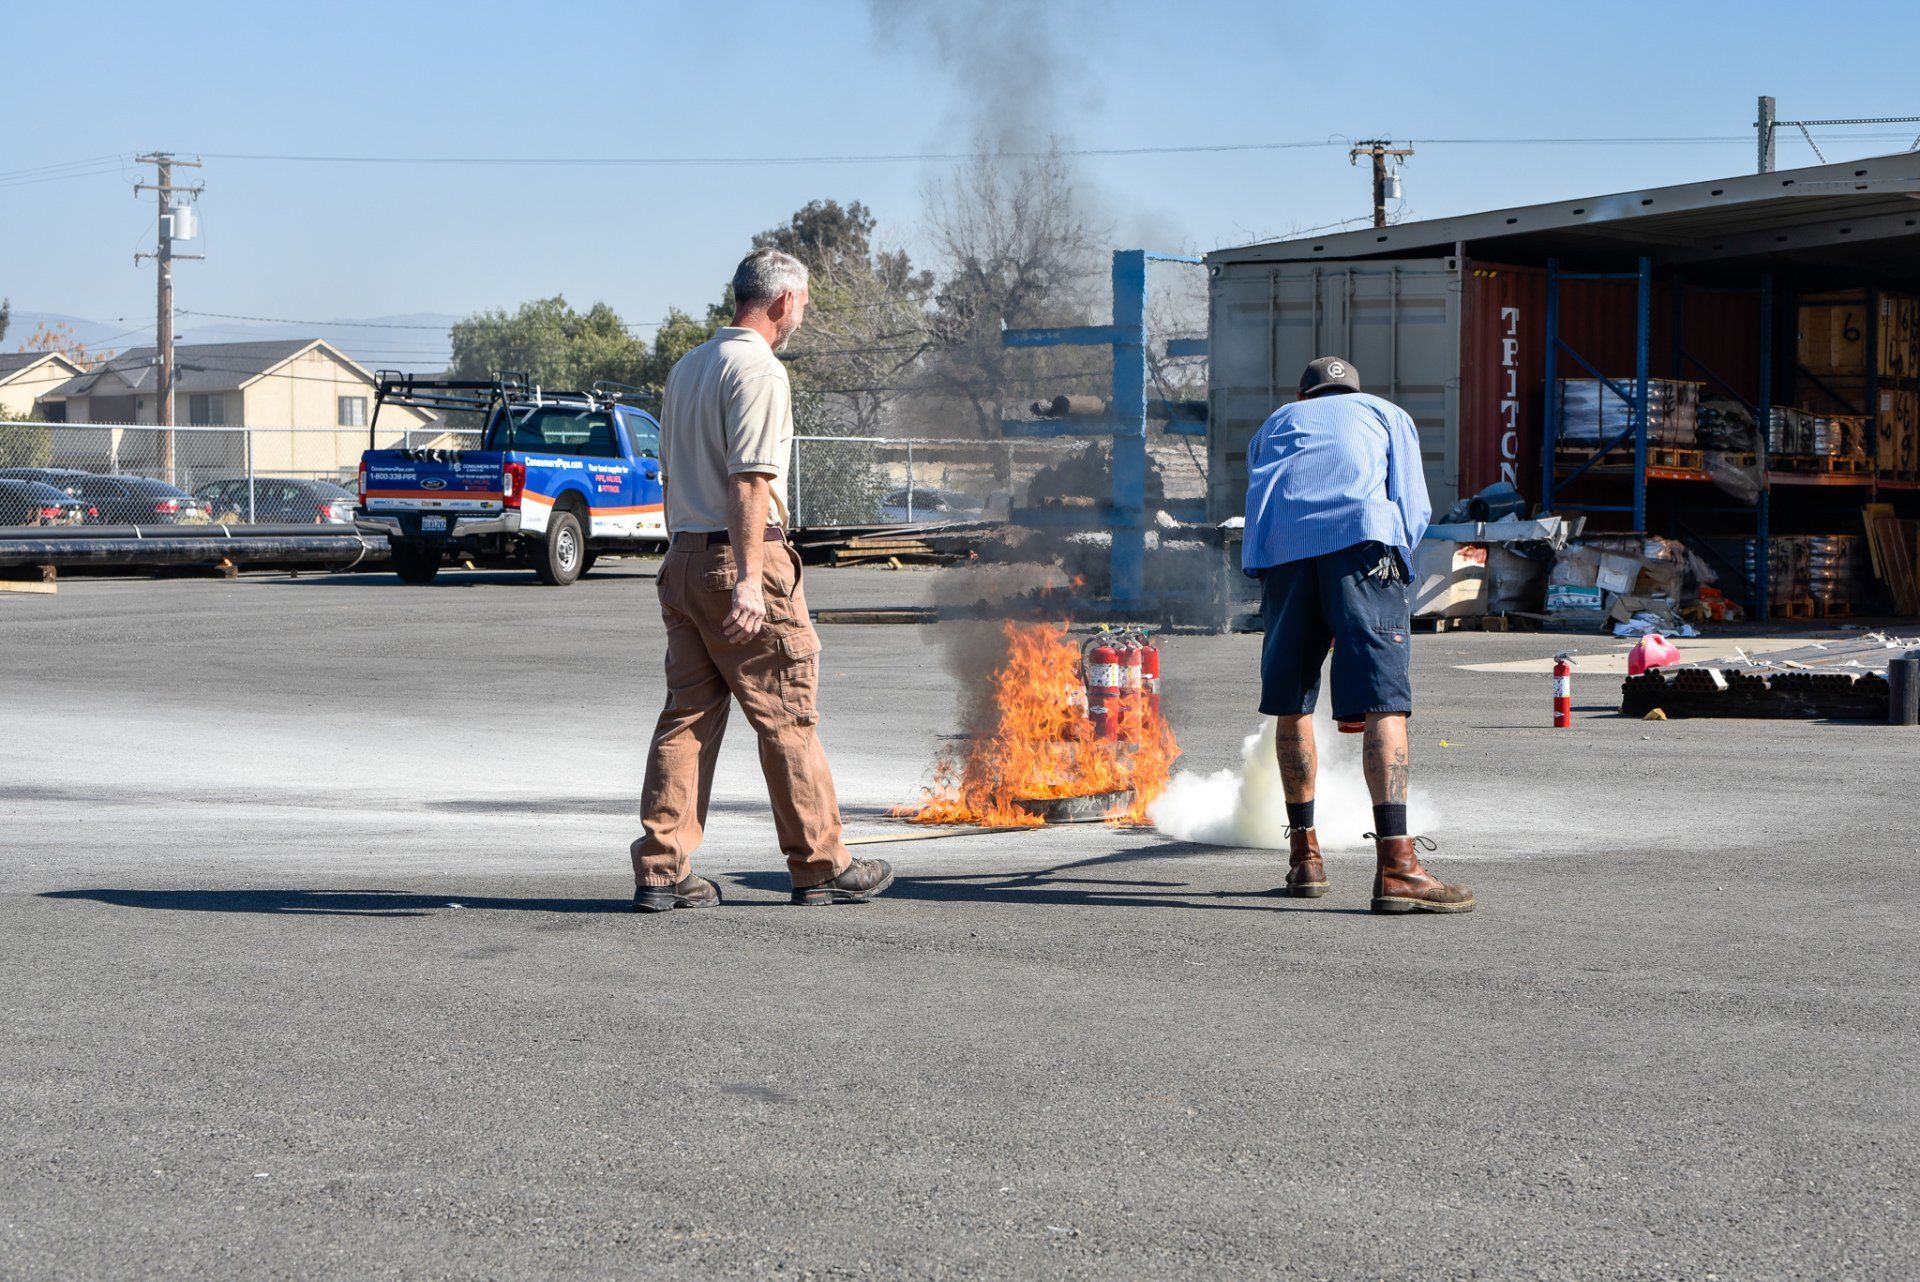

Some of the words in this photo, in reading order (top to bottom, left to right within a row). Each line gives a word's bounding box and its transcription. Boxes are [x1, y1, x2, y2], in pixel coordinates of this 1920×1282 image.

[1843, 312, 1860, 342] 6
[1501, 307, 1520, 489] TRITON
[525, 456, 583, 470] ConsumersPipe.com
